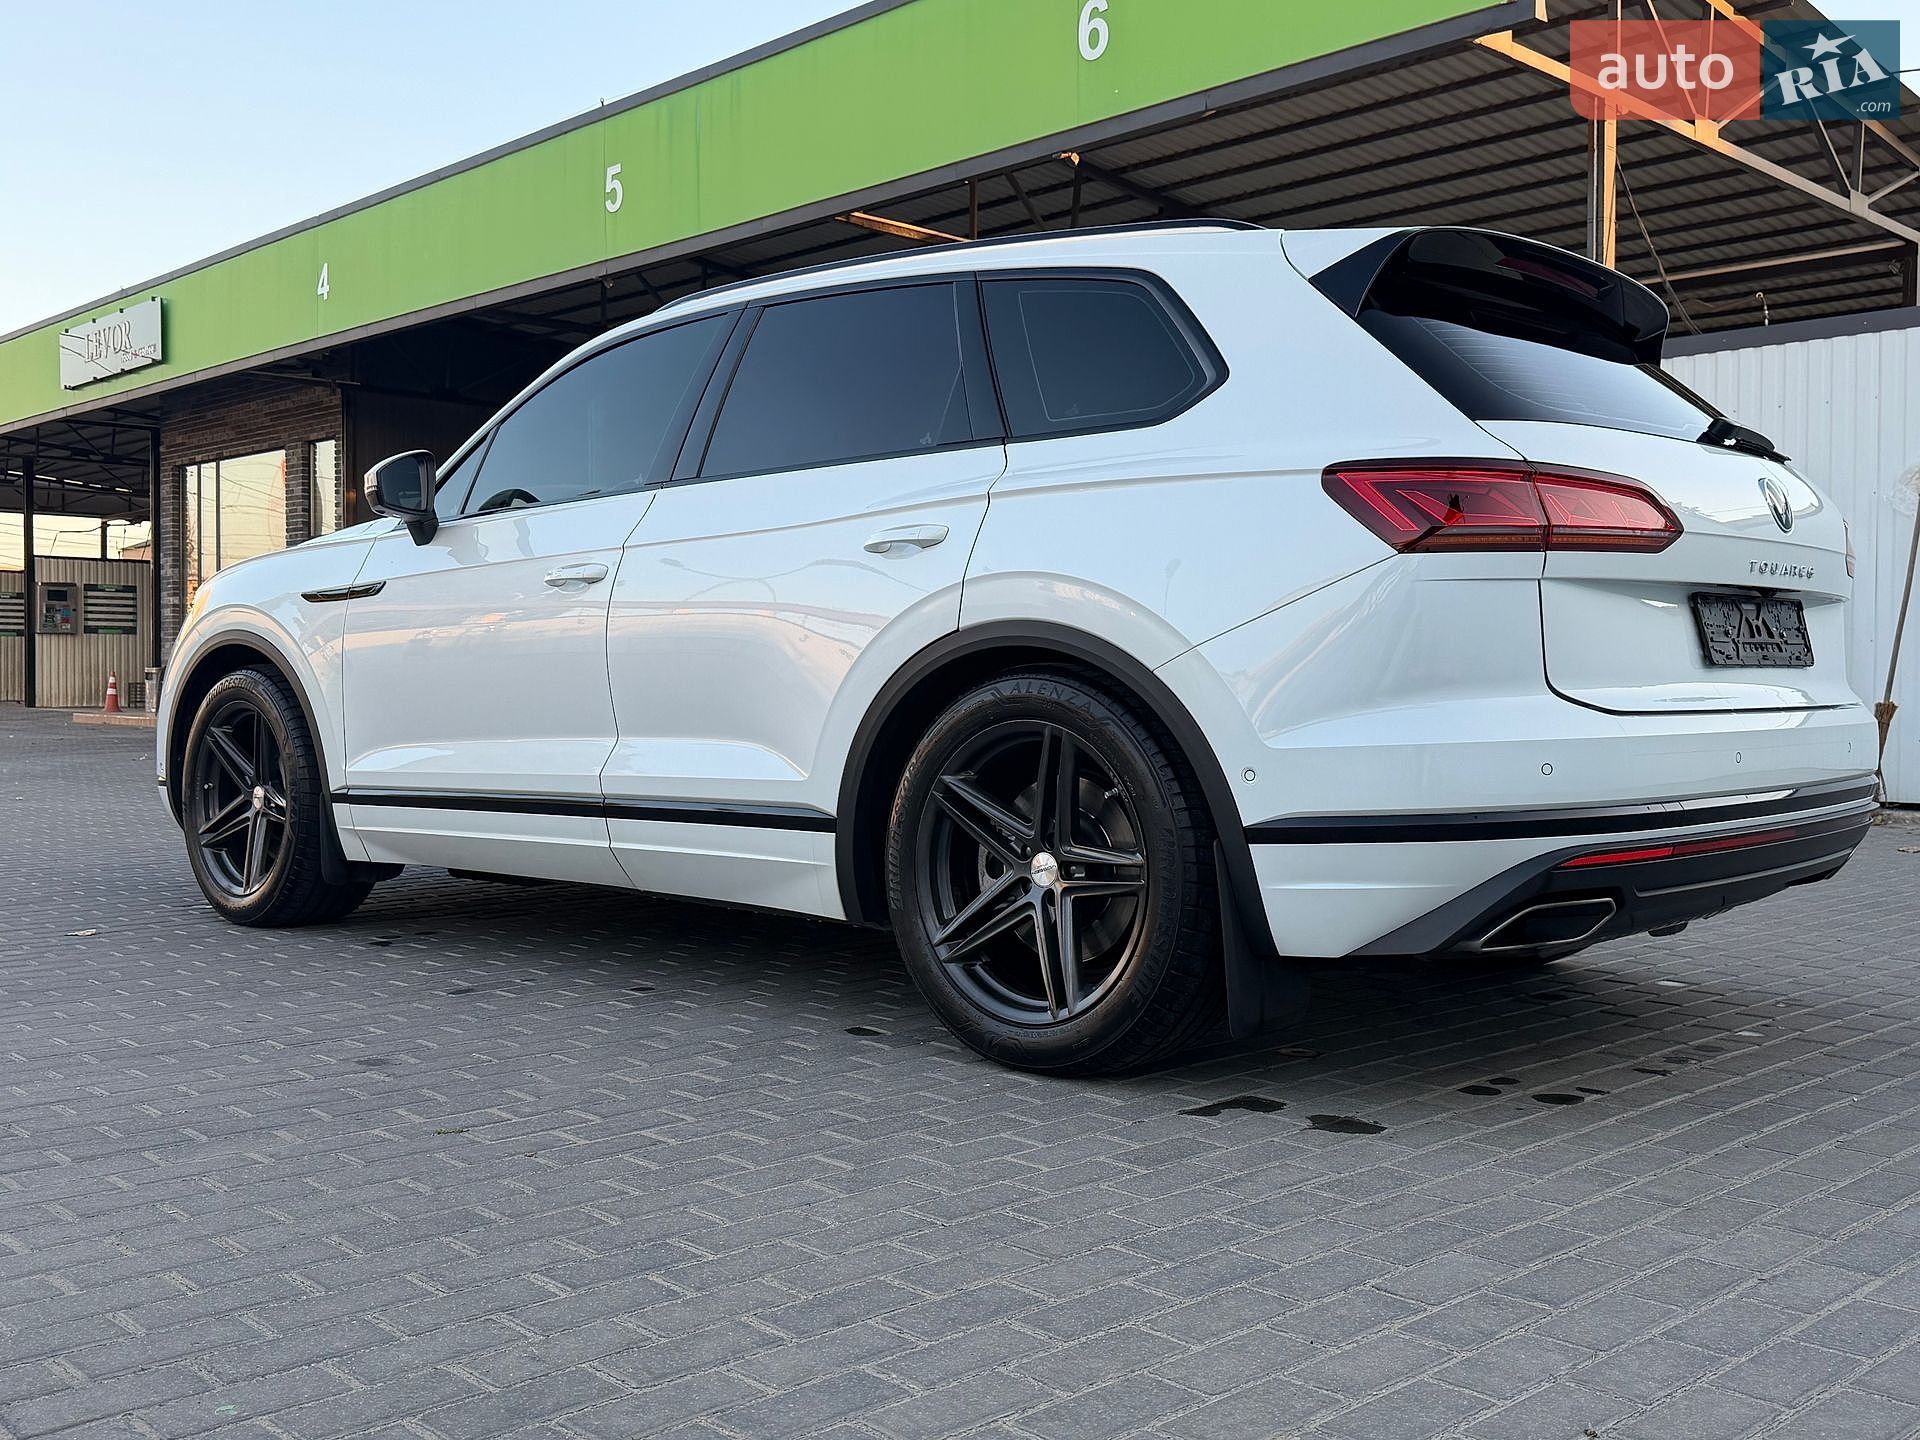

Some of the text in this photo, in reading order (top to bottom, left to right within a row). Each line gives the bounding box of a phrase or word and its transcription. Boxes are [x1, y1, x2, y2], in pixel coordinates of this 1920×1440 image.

[1079, 0, 1109, 60] 6
[605, 163, 623, 213] 5
[317, 262, 330, 300] 4
[85, 320, 133, 363] LEVOR
[1749, 559, 1815, 580] TOUAREG
